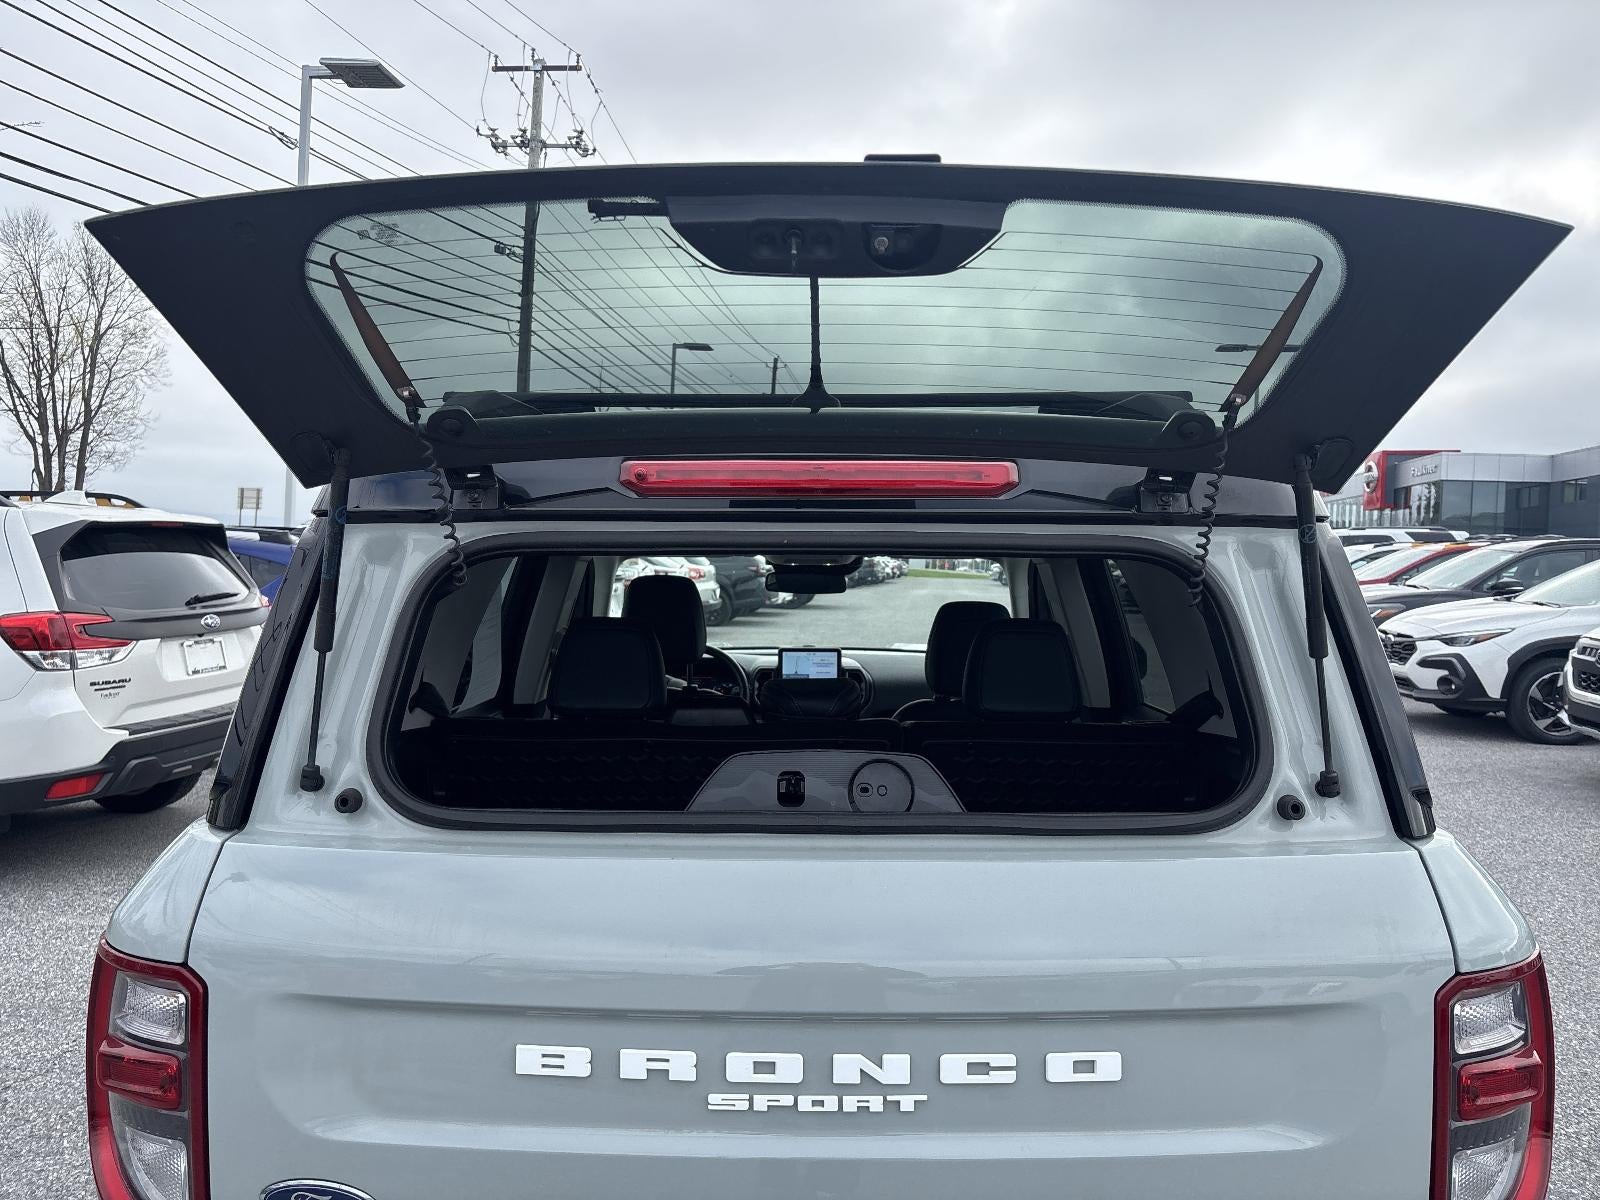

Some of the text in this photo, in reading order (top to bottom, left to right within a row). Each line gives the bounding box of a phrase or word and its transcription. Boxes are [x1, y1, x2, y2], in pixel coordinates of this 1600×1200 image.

[89, 678, 132, 687] SUBARU
[515, 1043, 1123, 1085] BRONCO
[707, 1093, 928, 1113] SPORT
